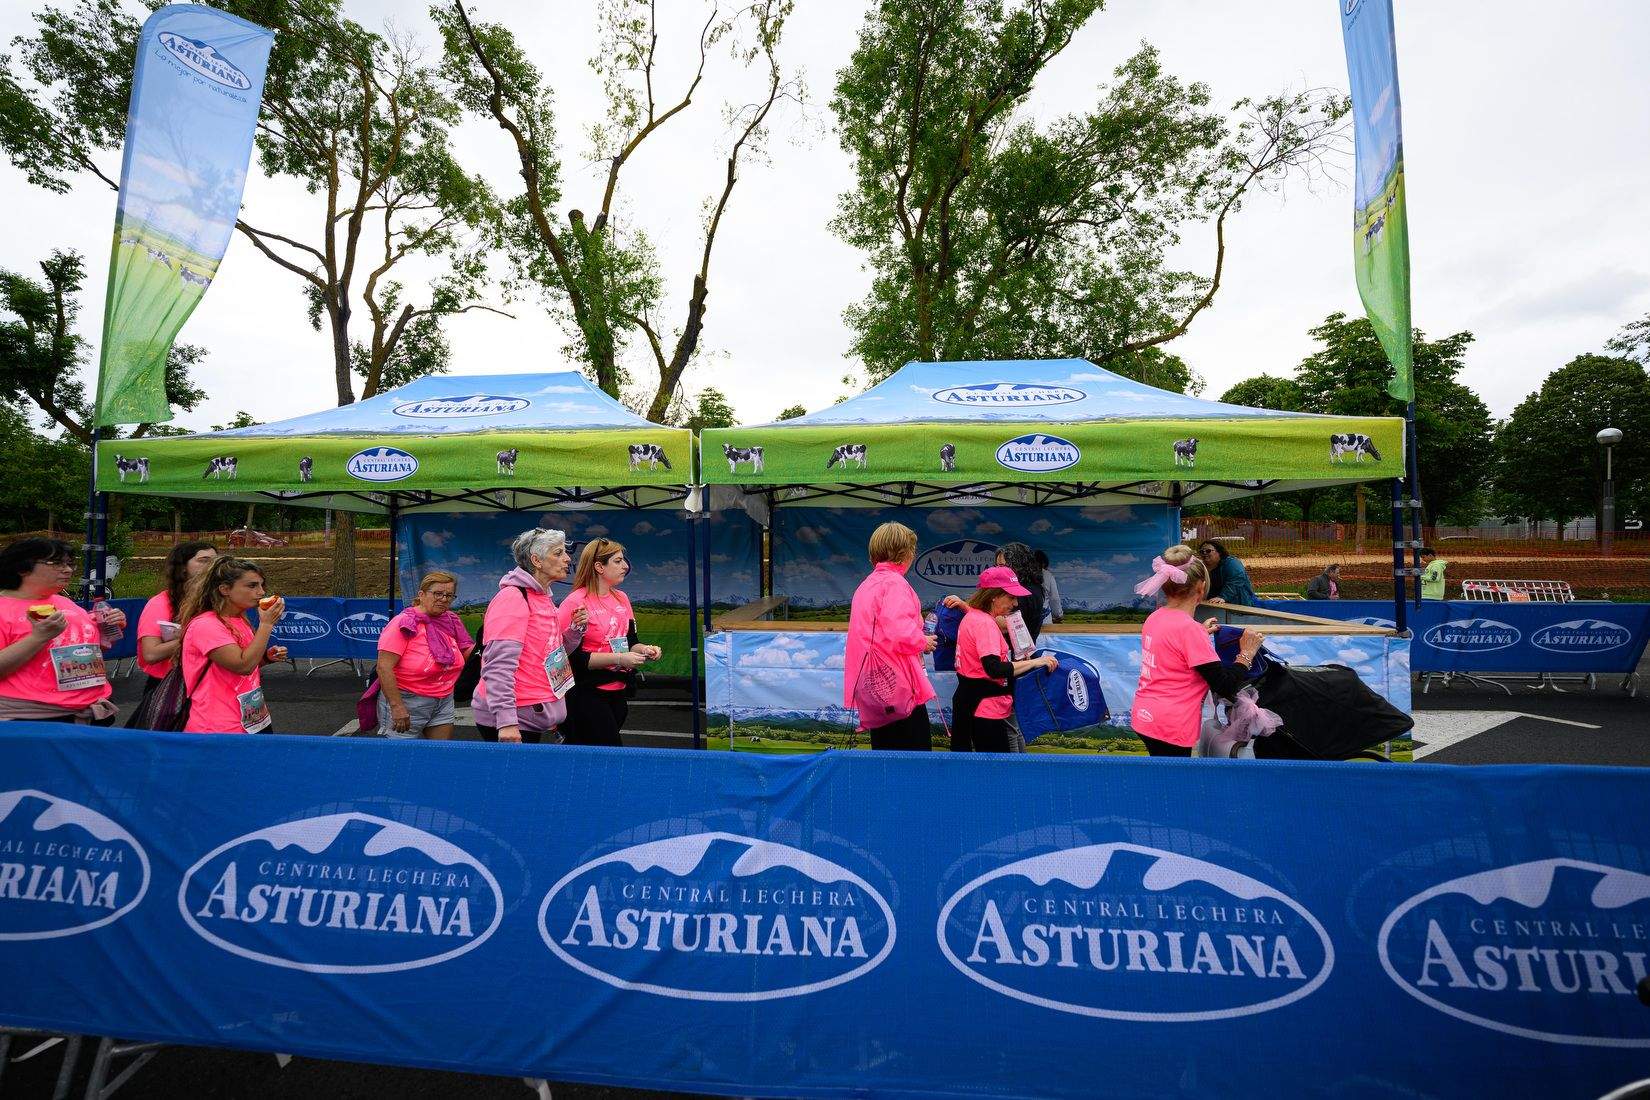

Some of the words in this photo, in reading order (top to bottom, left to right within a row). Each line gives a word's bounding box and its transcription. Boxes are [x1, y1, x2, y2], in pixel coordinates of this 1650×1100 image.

[164, 37, 244, 88] ASTURIANA
[948, 392, 1075, 402] ASTURIANA
[401, 404, 516, 414] ASTURIANA
[1003, 447, 1074, 462] ASTURIANA
[352, 460, 413, 472] ASTURIANA
[1431, 629, 1513, 645] ASTURIANA
[1537, 631, 1621, 645] ASTURIANA
[33, 841, 125, 863] LECHERA
[259, 861, 357, 881] CENTRAL
[367, 868, 471, 888] LECHERA
[196, 860, 475, 938] ASTURIANA
[622, 884, 730, 903] CENTRAL
[741, 888, 856, 907] LECHERA
[561, 884, 869, 958] ASTURIANA
[1023, 897, 1144, 919] CENTRAL
[1158, 903, 1285, 926] LECHERA
[966, 898, 1307, 980] ASTURIANA
[1470, 918, 1599, 939] CENTRAL
